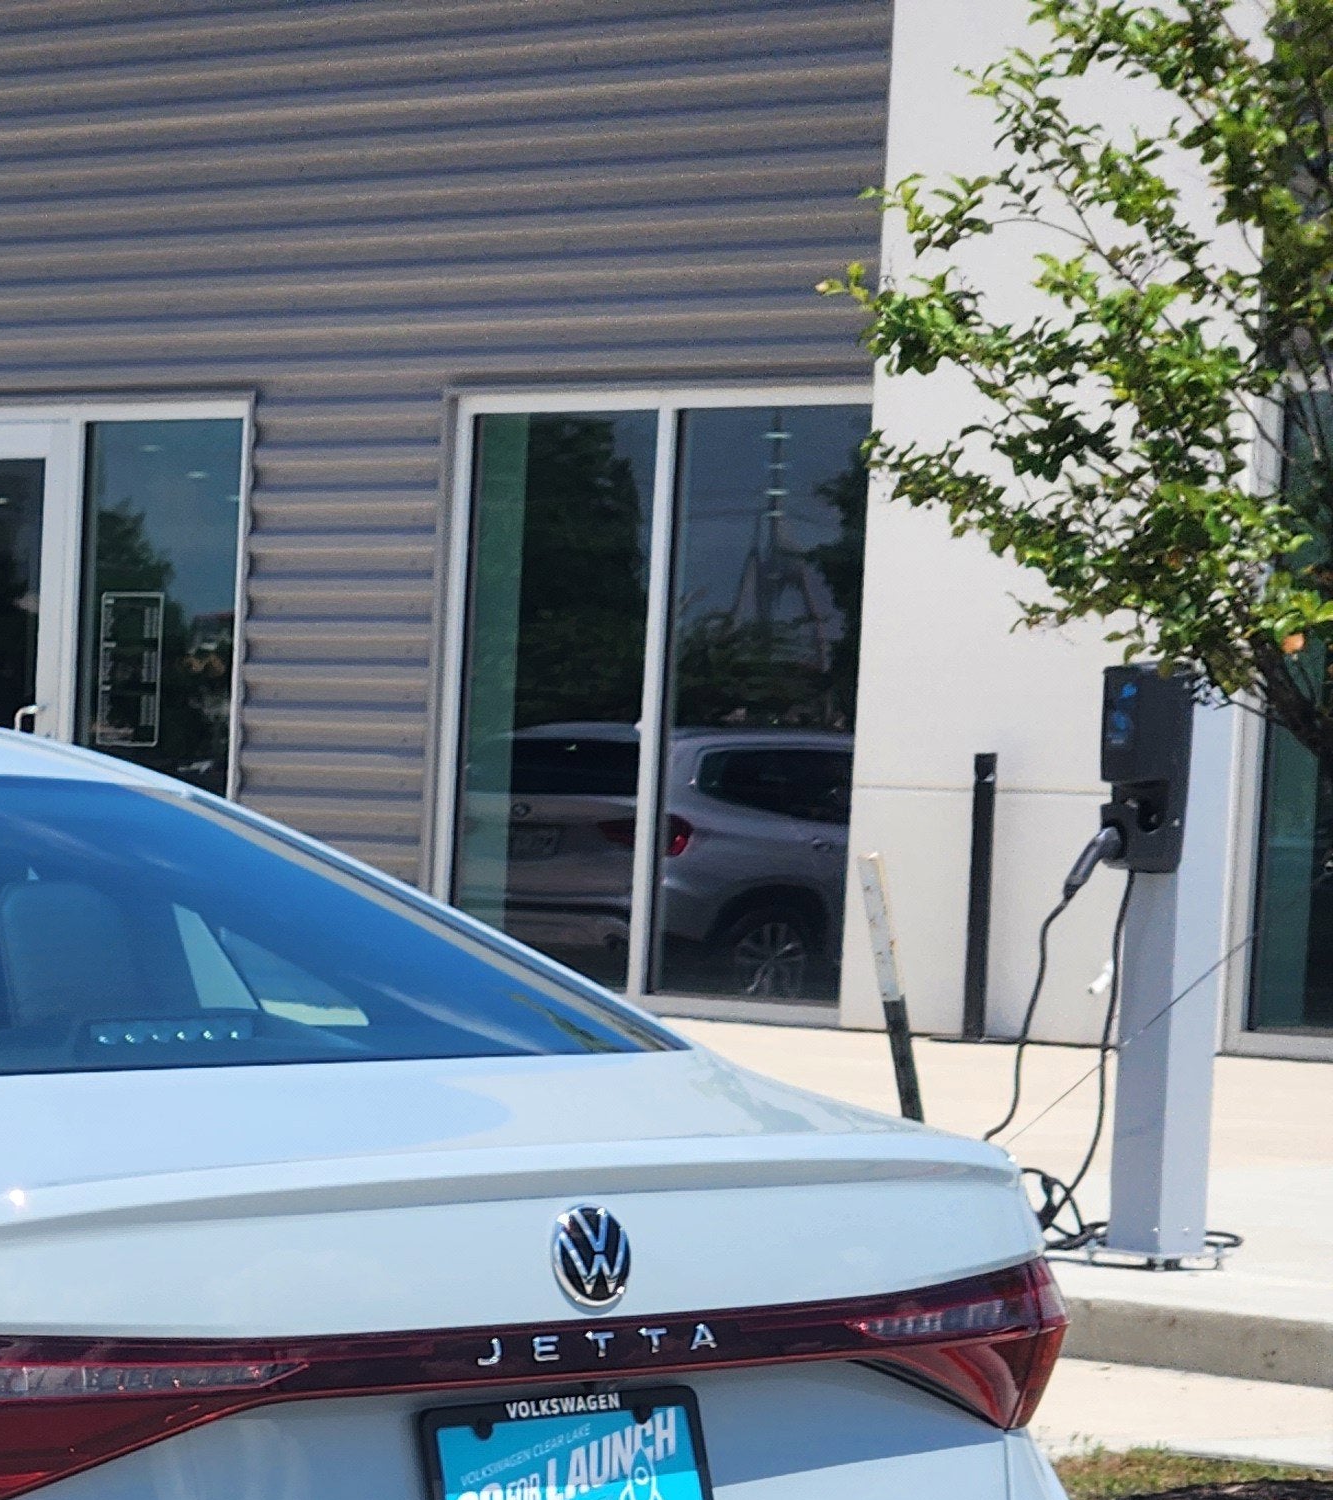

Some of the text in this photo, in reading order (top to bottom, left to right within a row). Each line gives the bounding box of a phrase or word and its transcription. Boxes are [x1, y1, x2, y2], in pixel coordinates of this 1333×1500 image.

[550, 1203, 631, 1308] VW
[476, 1322, 719, 1367] JETTA
[505, 1392, 621, 1420] VOLKSWAGEN
[533, 1431, 565, 1458] CLEAR
[566, 1421, 591, 1444] LAKE
